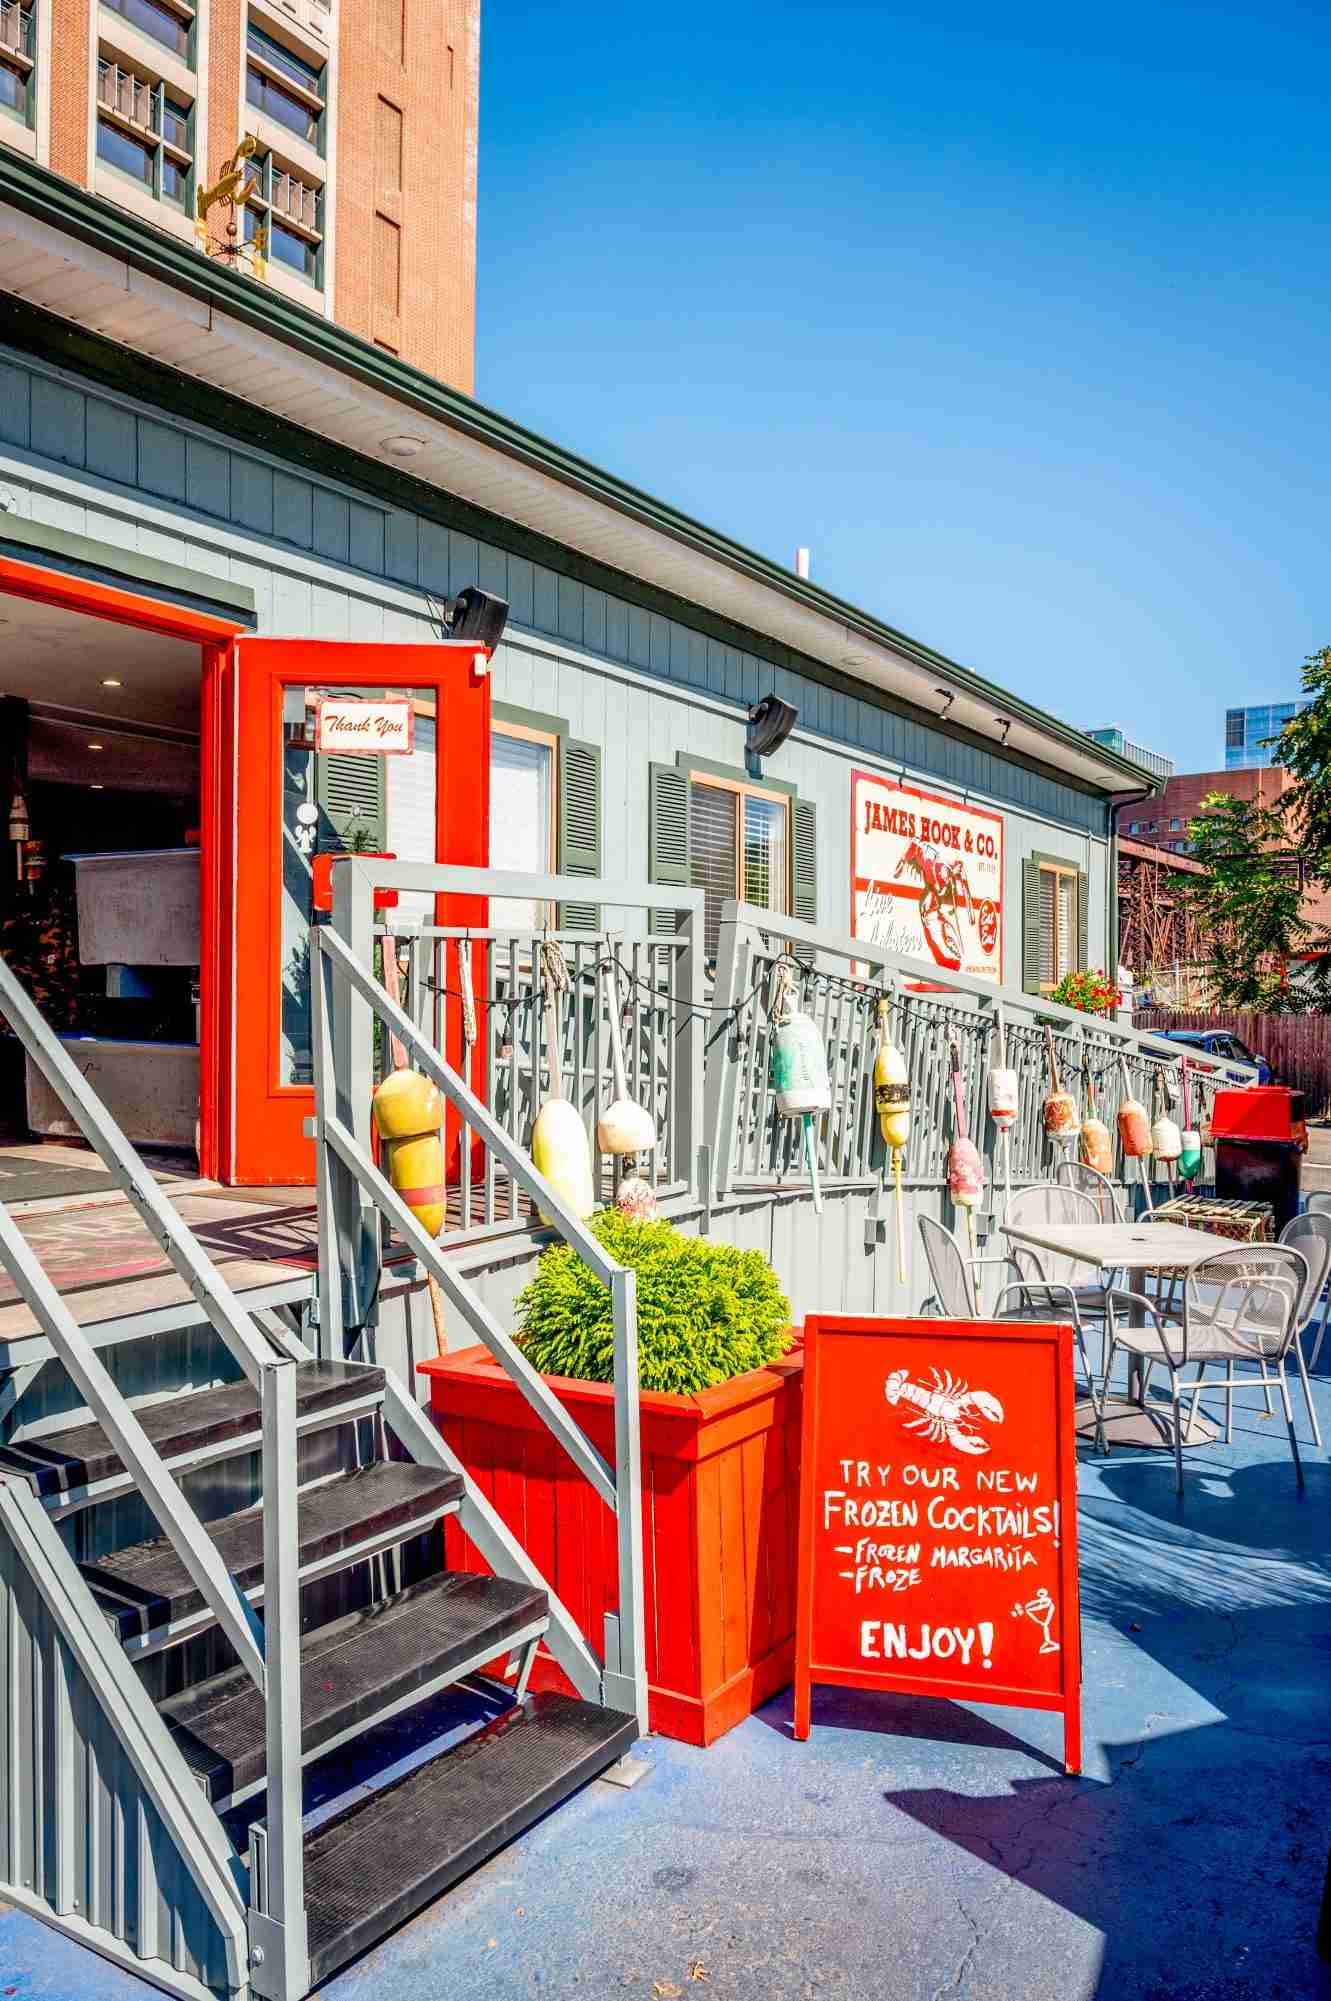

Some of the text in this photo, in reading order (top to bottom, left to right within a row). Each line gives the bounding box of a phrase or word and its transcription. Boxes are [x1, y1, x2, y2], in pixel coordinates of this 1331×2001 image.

[324, 714, 404, 738] Thank You
[864, 800, 998, 860] JAMES HOOK & CO.
[840, 1459, 1038, 1493] TRY OUR NEW
[824, 1490, 919, 1530] FROZEN
[861, 1620, 994, 1669] ENJOY!
